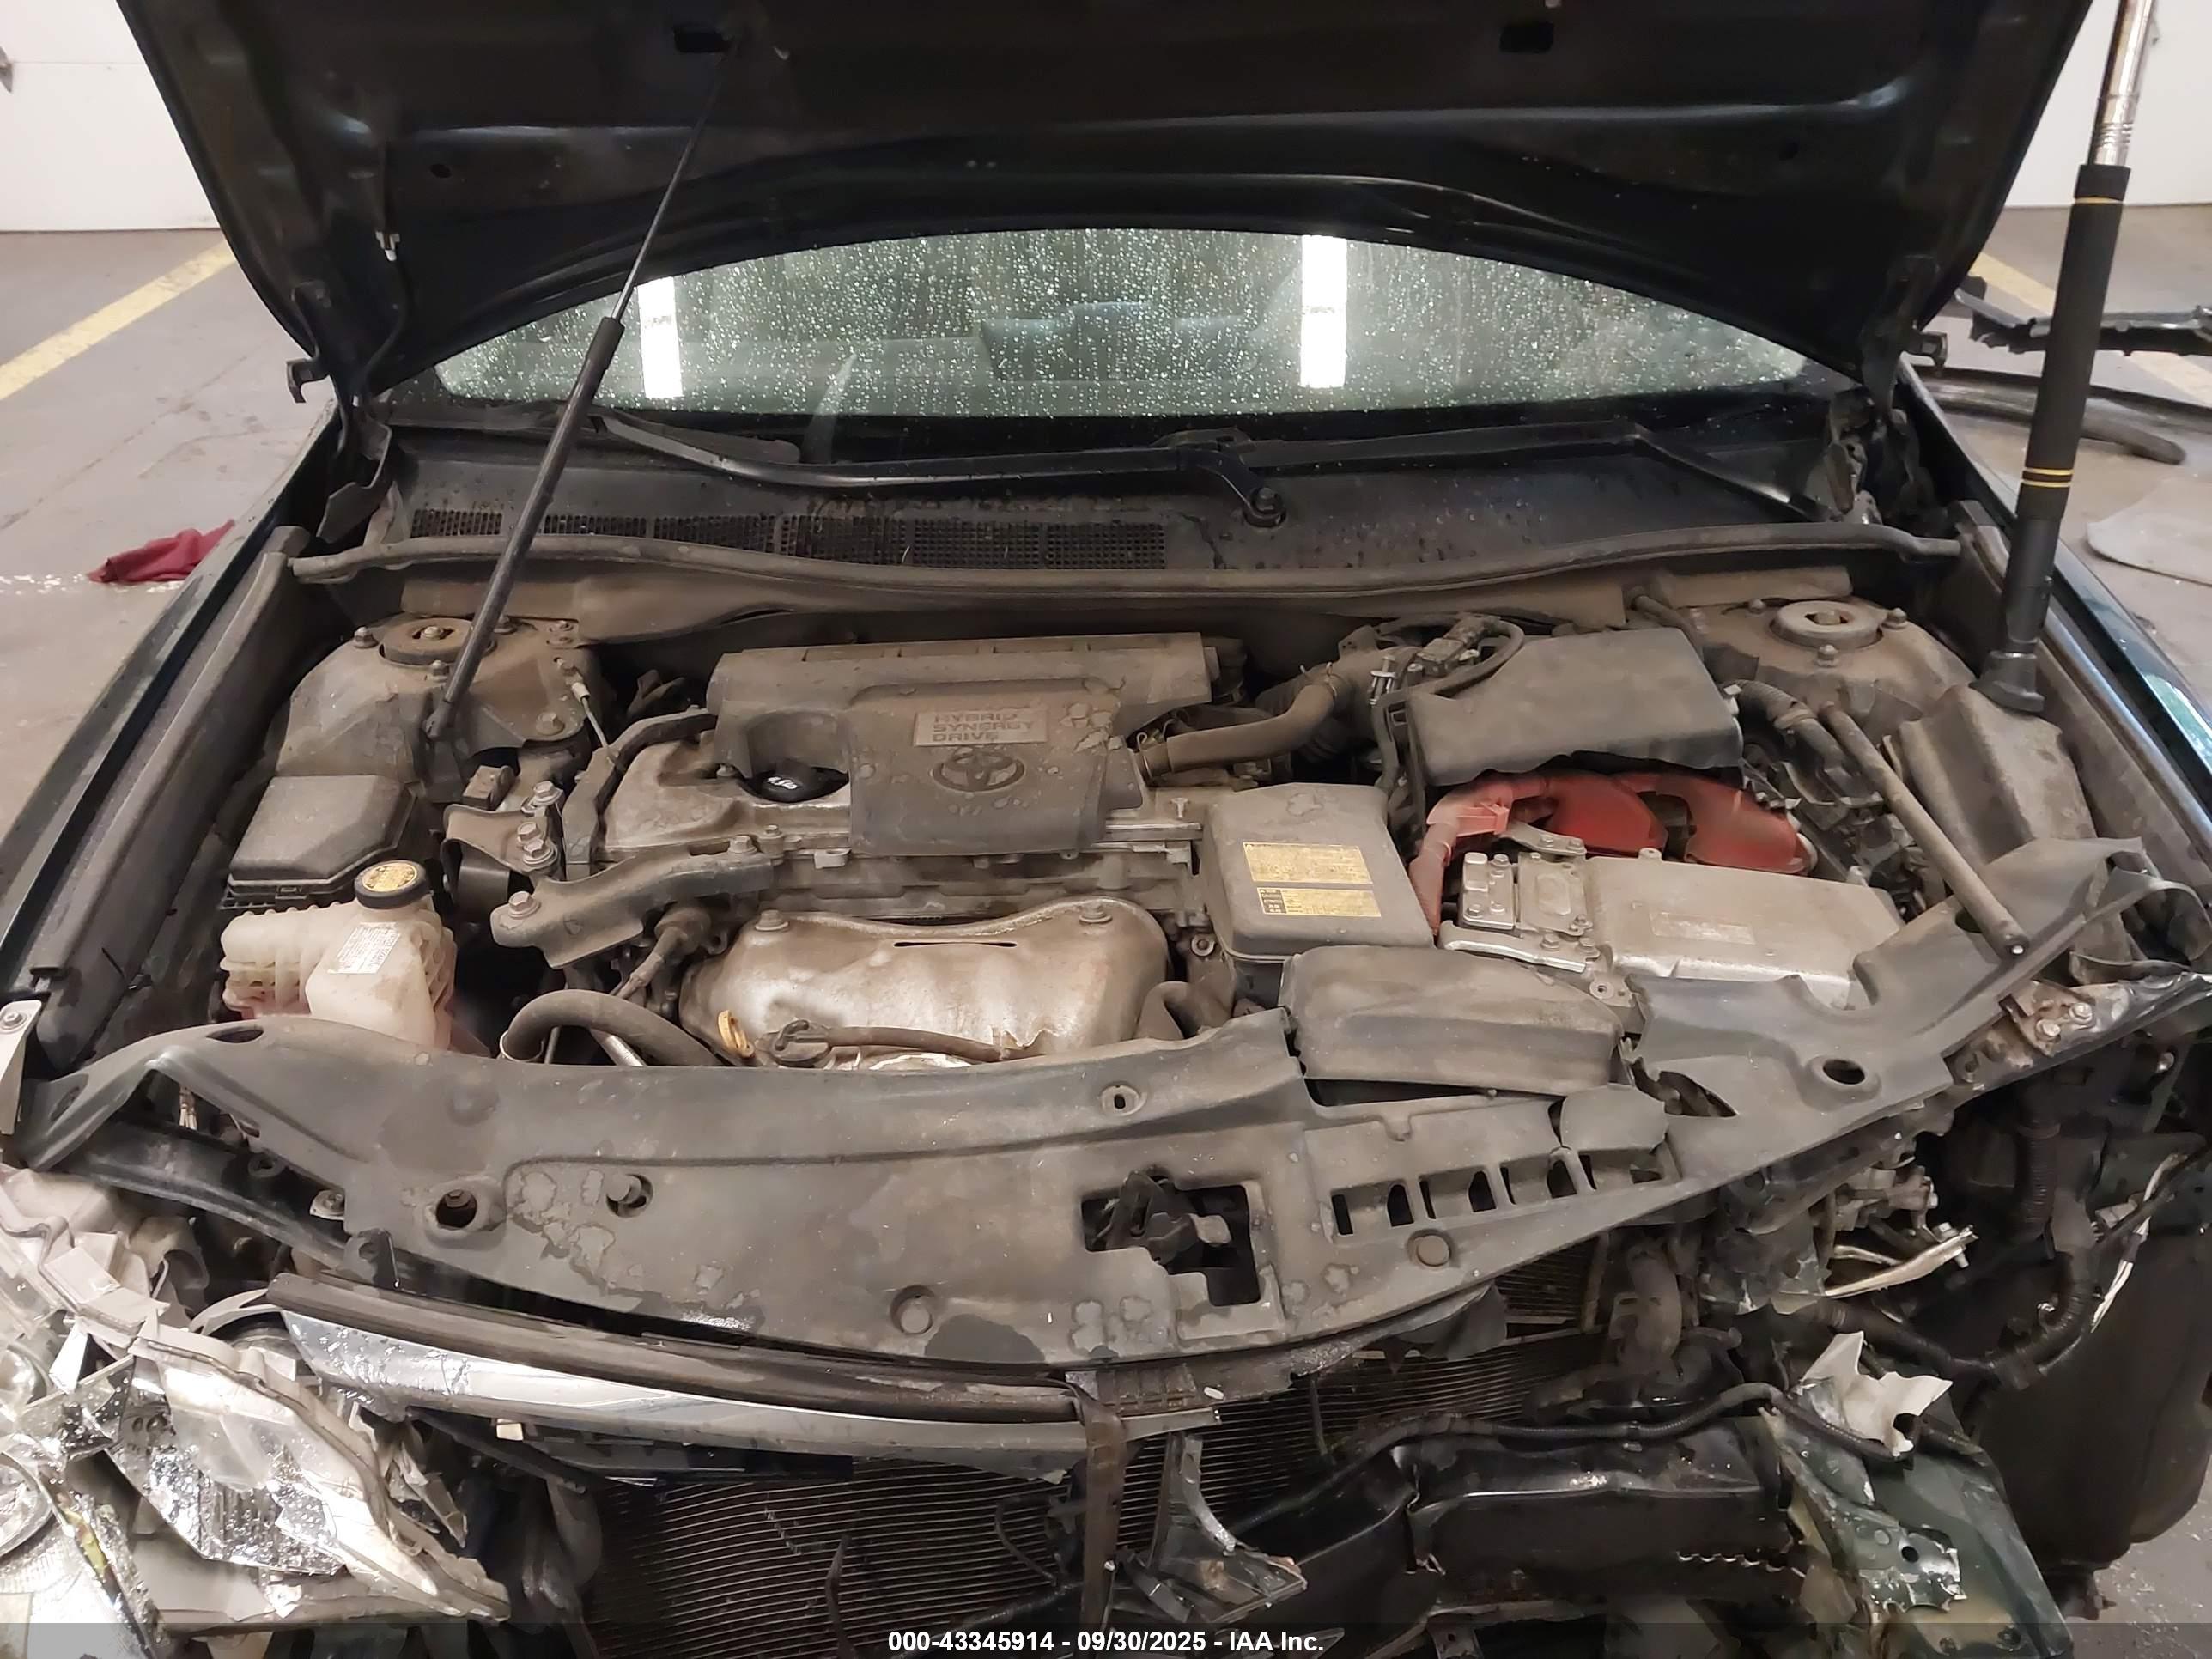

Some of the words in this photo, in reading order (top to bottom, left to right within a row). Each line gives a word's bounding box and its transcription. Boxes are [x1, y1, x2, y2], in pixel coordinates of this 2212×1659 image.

[934, 714, 1018, 723] HYBRID
[933, 721, 1033, 732] SYNERGY
[932, 732, 1000, 742] DRIVE
